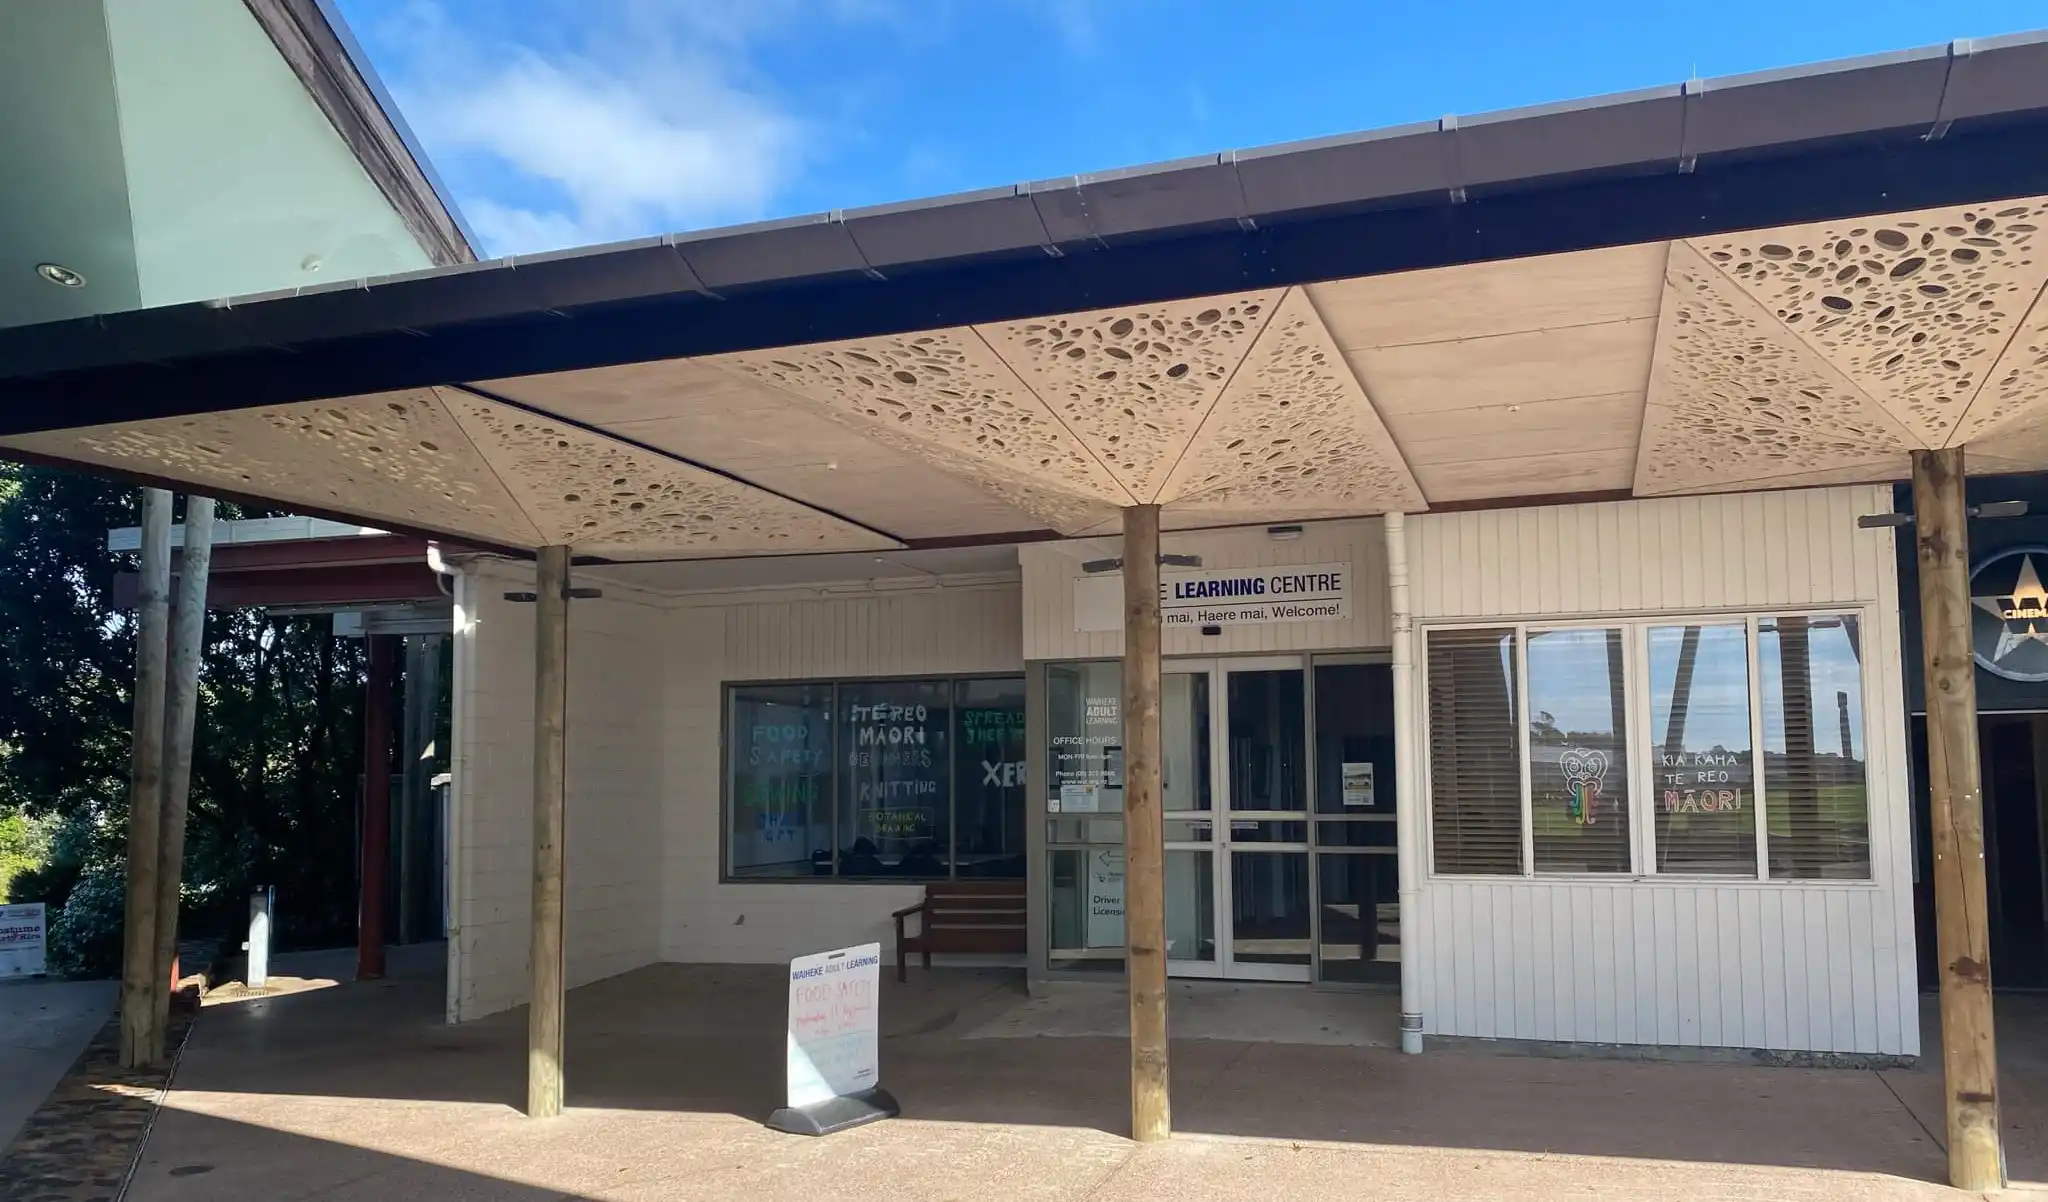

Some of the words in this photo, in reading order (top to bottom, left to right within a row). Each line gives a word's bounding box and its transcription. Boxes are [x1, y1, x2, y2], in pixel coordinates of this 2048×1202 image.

[1175, 577, 1265, 599] LEARNING
[1270, 573, 1342, 594] CENTRE
[1167, 612, 1193, 624] mai,
[1198, 610, 1236, 622] Haere
[1240, 608, 1268, 620] mai,
[1272, 603, 1340, 617] Welcome!
[2003, 608, 2048, 619] CINEM
[1087, 706, 1117, 716] ADULT
[753, 725, 808, 743] FOOD
[1053, 736, 1085, 745] OFFICE
[1086, 736, 1117, 744] HOURS
[750, 746, 824, 766] SAFETY
[1662, 754, 1685, 767] KIA
[1695, 753, 1738, 766] KAHA
[1665, 773, 1685, 785] TE
[1697, 771, 1729, 783] REO
[860, 779, 937, 800] KNITTING
[1664, 788, 1741, 812] MĀORI
[1093, 895, 1120, 904] Driver
[792, 966, 824, 980] WAIHEKE
[825, 962, 845, 974] ADULT
[846, 955, 879, 970] LEARNING
